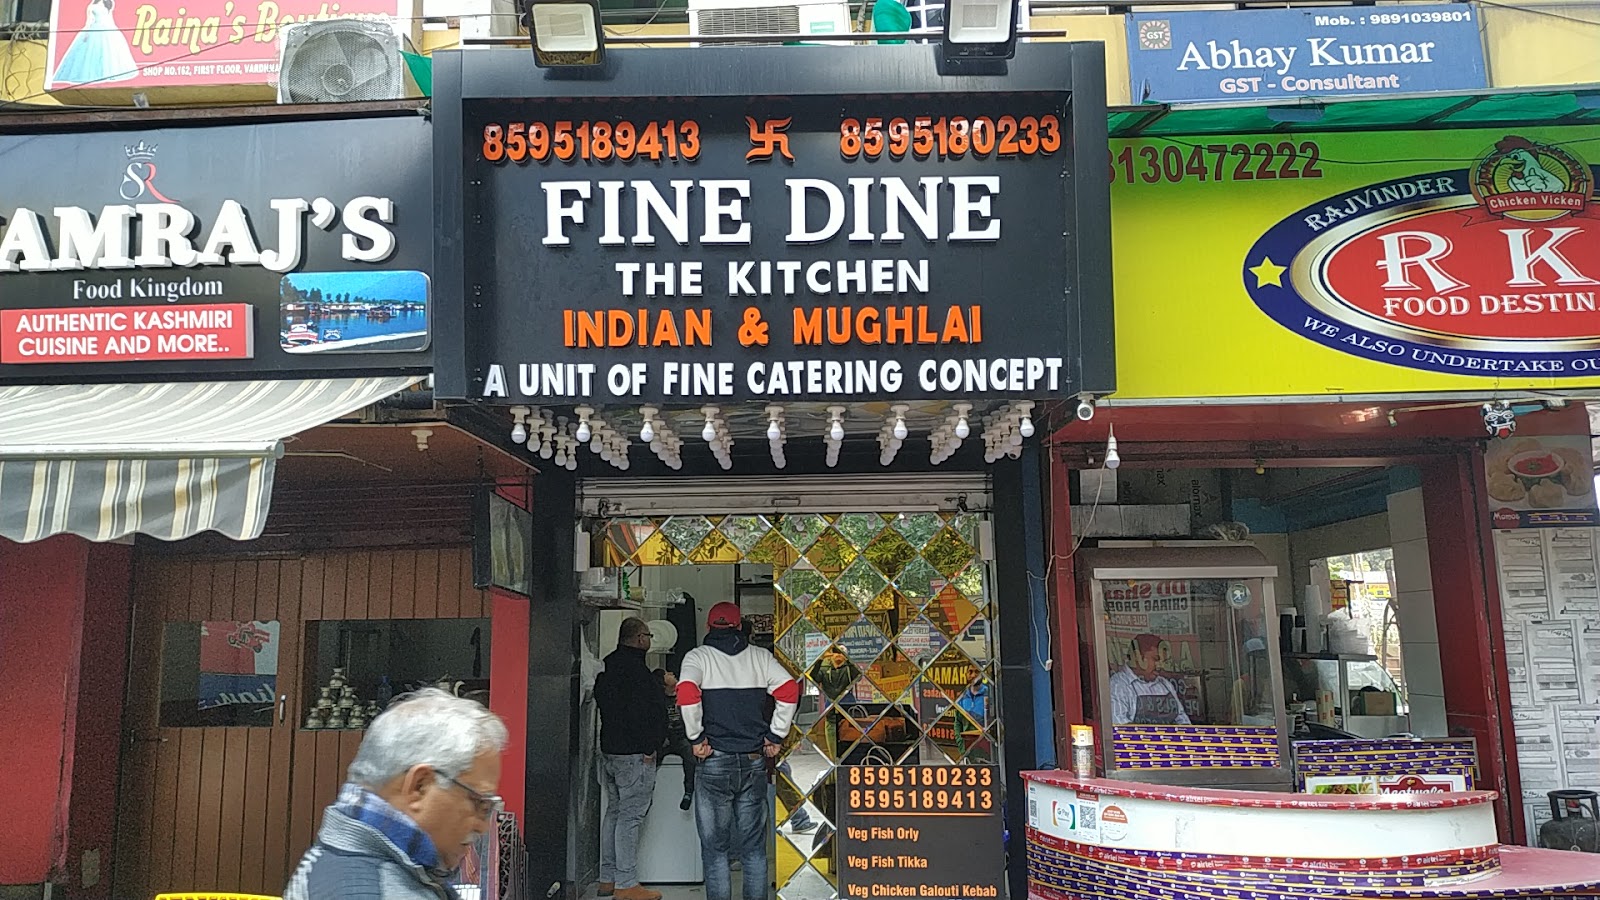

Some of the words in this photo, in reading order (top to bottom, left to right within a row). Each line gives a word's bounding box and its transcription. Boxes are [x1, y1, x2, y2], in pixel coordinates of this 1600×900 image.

[132, 1, 248, 55] Raina's
[1315, 15, 1355, 27] Mob.
[1370, 11, 1471, 25] 9891039801
[1146, 31, 1164, 40] GST
[1177, 41, 1297, 76] Abhay
[1307, 37, 1435, 68] Kumar
[143, 66, 162, 77] SHOP
[193, 64, 215, 75] FIRST
[216, 63, 243, 78] FLOOR,
[1219, 76, 1263, 94] GST
[1281, 73, 1399, 92] Consultant
[483, 119, 701, 162] 8595189413
[840, 114, 1061, 158] 8595180233
[540, 179, 751, 246] FINE
[784, 175, 1001, 244] DINE
[1304, 176, 1459, 232] RAJVINDER
[1490, 195, 1537, 208] Chicken
[1541, 194, 1581, 206] Vicken
[1375, 230, 1470, 296] R
[1498, 226, 1600, 288] K
[73, 278, 122, 301] Food
[130, 277, 224, 303] Kingdom
[615, 261, 703, 296] THE
[728, 259, 929, 296] KITCHEN
[1384, 295, 1470, 317] FOOD
[1480, 291, 1600, 315] DESTIN
[16, 312, 128, 334] AUTHENTIC
[133, 309, 234, 331] KASHMIRI
[563, 308, 713, 348] INDIAN
[738, 306, 769, 348] &
[793, 304, 982, 346] MUGHLAI
[18, 336, 98, 357] CUISINE
[104, 333, 152, 354] AND
[157, 331, 230, 353] MORE..
[1303, 315, 1340, 339] WE
[1341, 330, 1406, 356] ALSO
[1411, 348, 1565, 373] UNDERTAKE
[483, 364, 509, 398] A
[519, 363, 596, 397] UNIT
[607, 363, 647, 397] OF
[663, 361, 735, 396] FINE
[747, 359, 903, 395] CATERING
[918, 357, 1063, 392] CONCEPT
[849, 767, 992, 786] 8595180233
[849, 789, 993, 810] 8595189413
[848, 827, 868, 841] Veg
[871, 827, 894, 840] Fish
[897, 827, 919, 841] Orly
[848, 855, 868, 870] Veg
[871, 855, 894, 868] Fish
[897, 856, 928, 869] Tikka
[1197, 860, 1215, 868] airtel
[1309, 861, 1329, 869] airtel
[1422, 854, 1438, 864] airtel
[848, 883, 869, 899] Veg
[871, 883, 916, 897] Chicken
[919, 884, 960, 897] Galouti
[962, 885, 997, 897] Kebab
